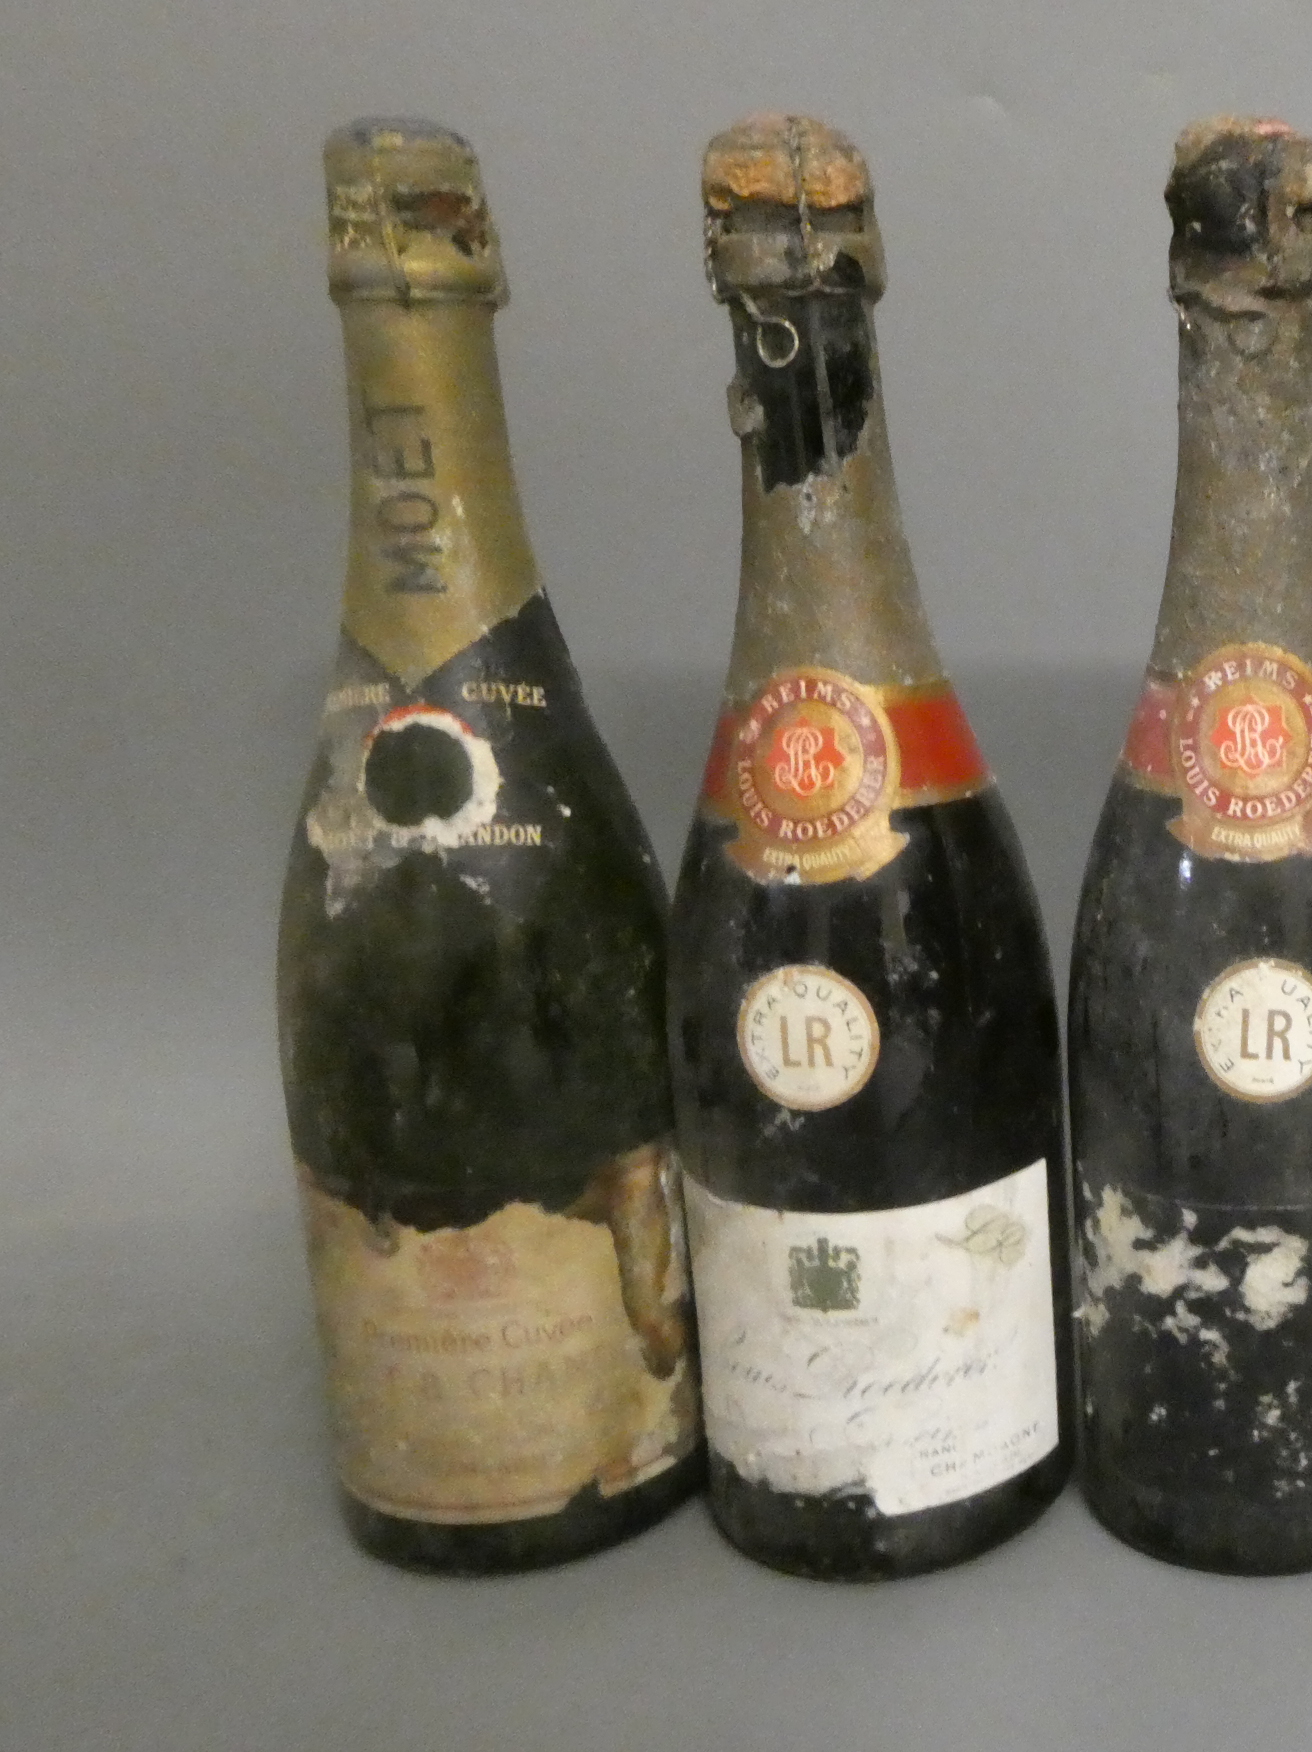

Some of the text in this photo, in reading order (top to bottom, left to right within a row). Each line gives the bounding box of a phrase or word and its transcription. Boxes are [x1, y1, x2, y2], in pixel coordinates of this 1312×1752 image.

[761, 679, 853, 714] REIMS
[1204, 657, 1300, 691] REIMS
[735, 754, 886, 843] LOUIS ROEDERER
[1178, 738, 1220, 808] LOUIS
[444, 823, 543, 849] ANDON
[1210, 825, 1302, 849] EXTRA QUALITY
[749, 981, 865, 1080] EXTRA QUALITY
[779, 1014, 835, 1069] LR
[1239, 1007, 1294, 1062] LR
